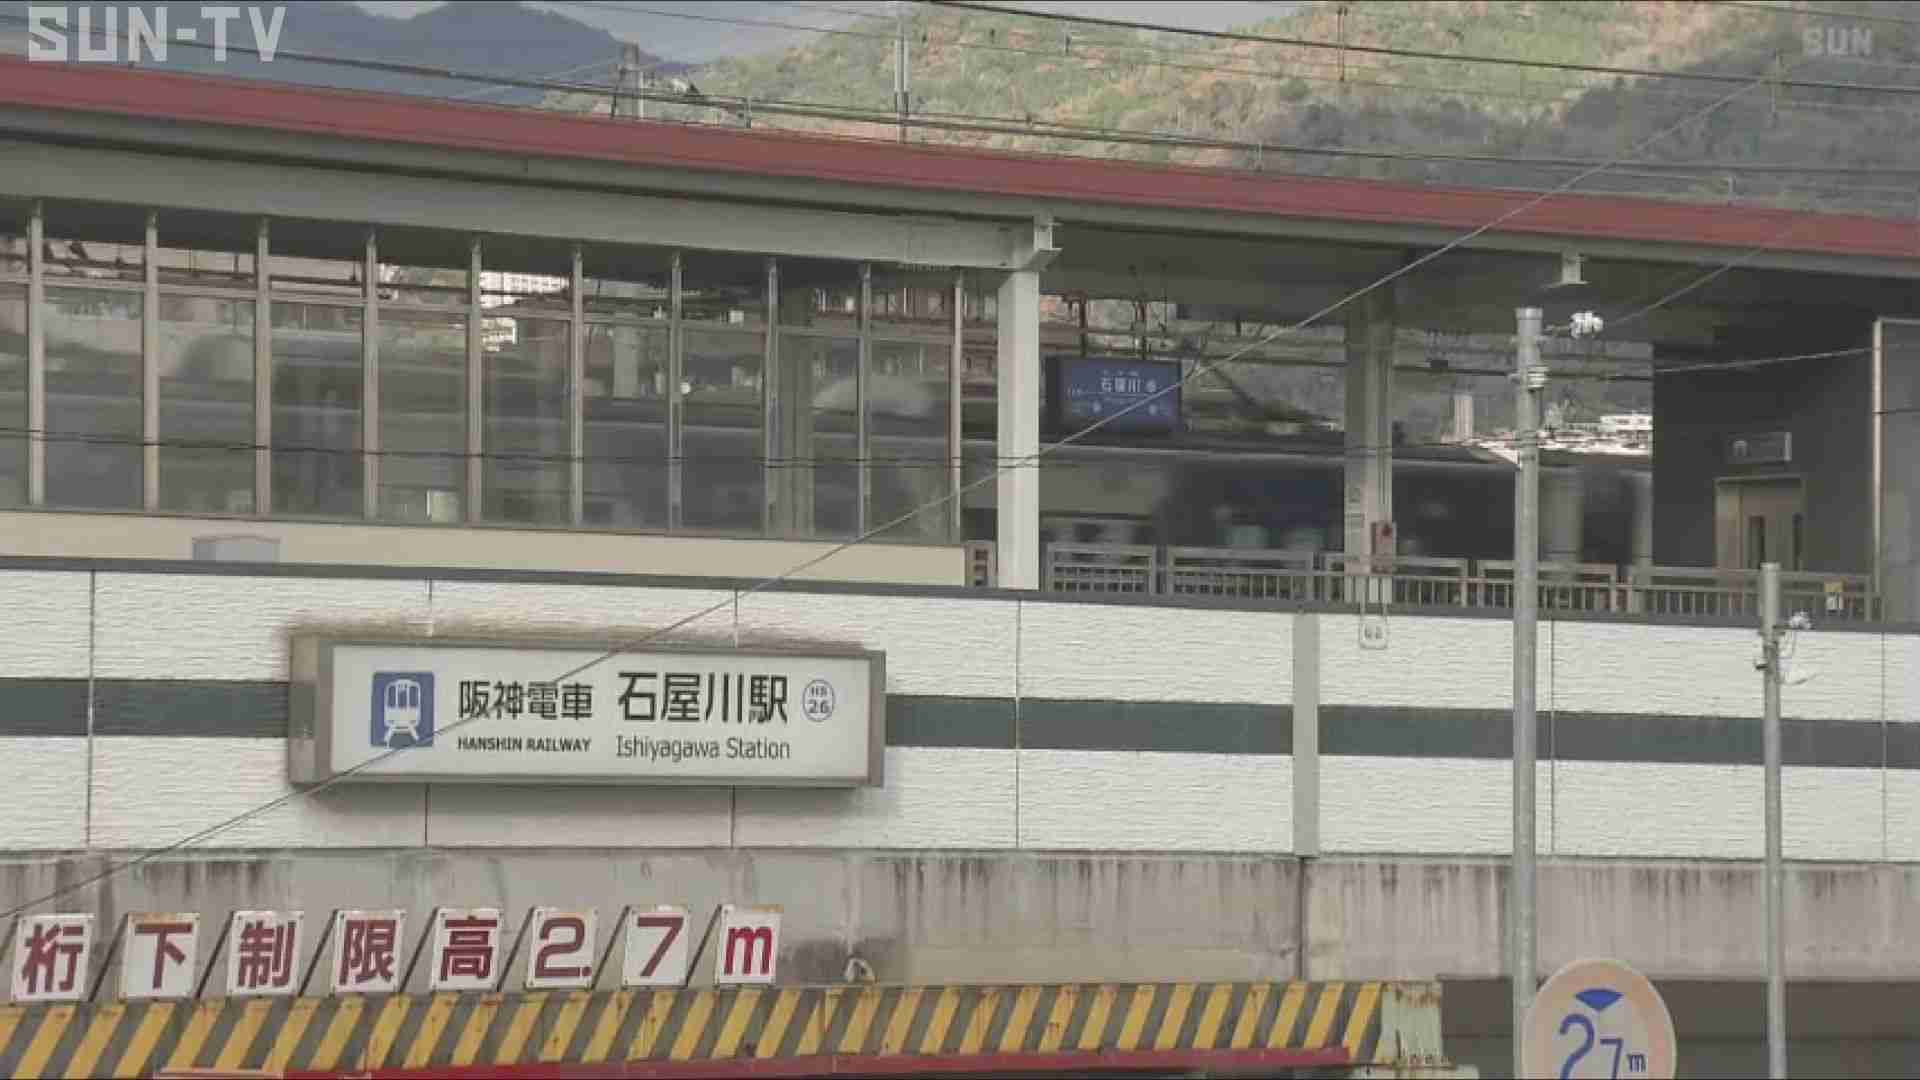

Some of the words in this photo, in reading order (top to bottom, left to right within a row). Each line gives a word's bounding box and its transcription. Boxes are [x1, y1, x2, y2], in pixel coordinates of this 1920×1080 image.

[459, 680, 592, 720] 阪神電車
[618, 672, 788, 723] 石屋川駅
[808, 699, 830, 714] 26
[457, 736, 523, 751] HANSHIN
[526, 736, 592, 751] RAILWAY
[616, 735, 720, 762] Ishiyagawa
[726, 736, 790, 759] Station
